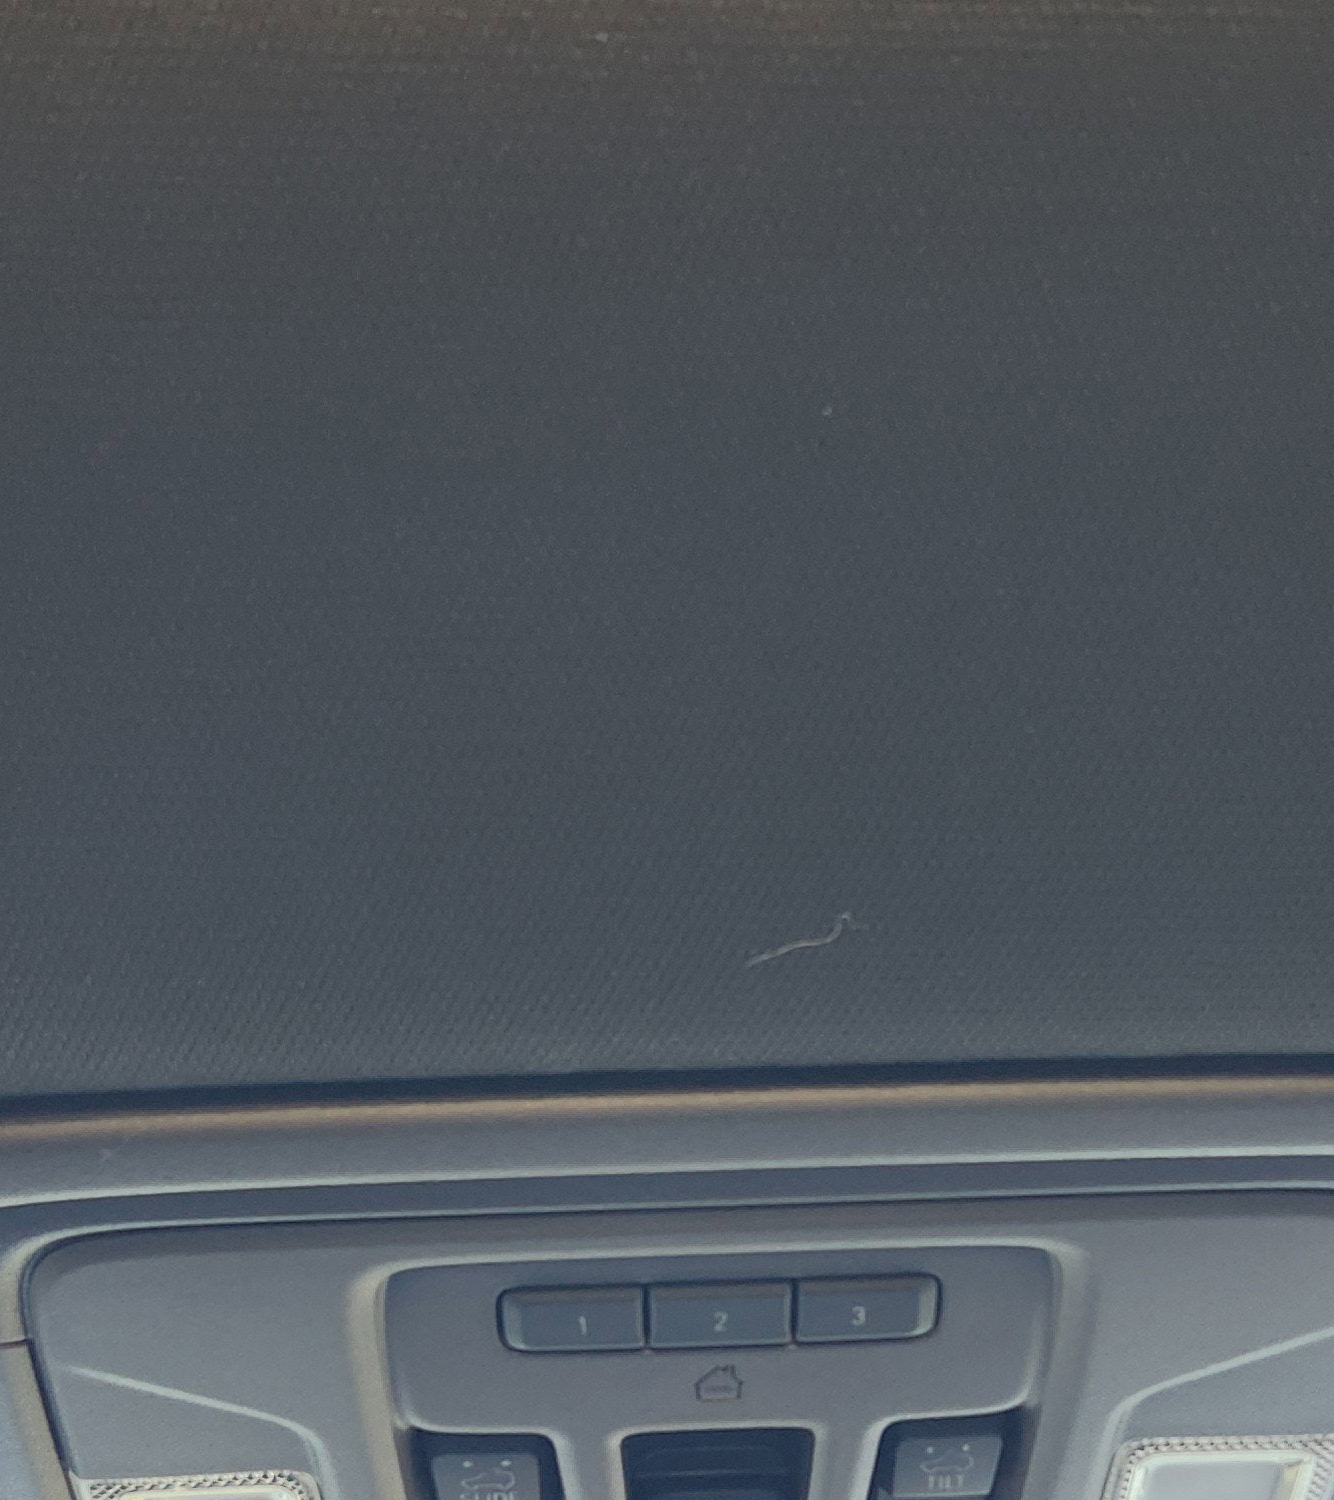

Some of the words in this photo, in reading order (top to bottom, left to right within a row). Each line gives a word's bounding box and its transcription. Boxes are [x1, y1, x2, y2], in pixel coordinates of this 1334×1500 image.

[579, 1316, 588, 1335] 1
[713, 1312, 728, 1331] 2
[851, 1306, 866, 1325] 3
[925, 1474, 965, 1490] TILT
